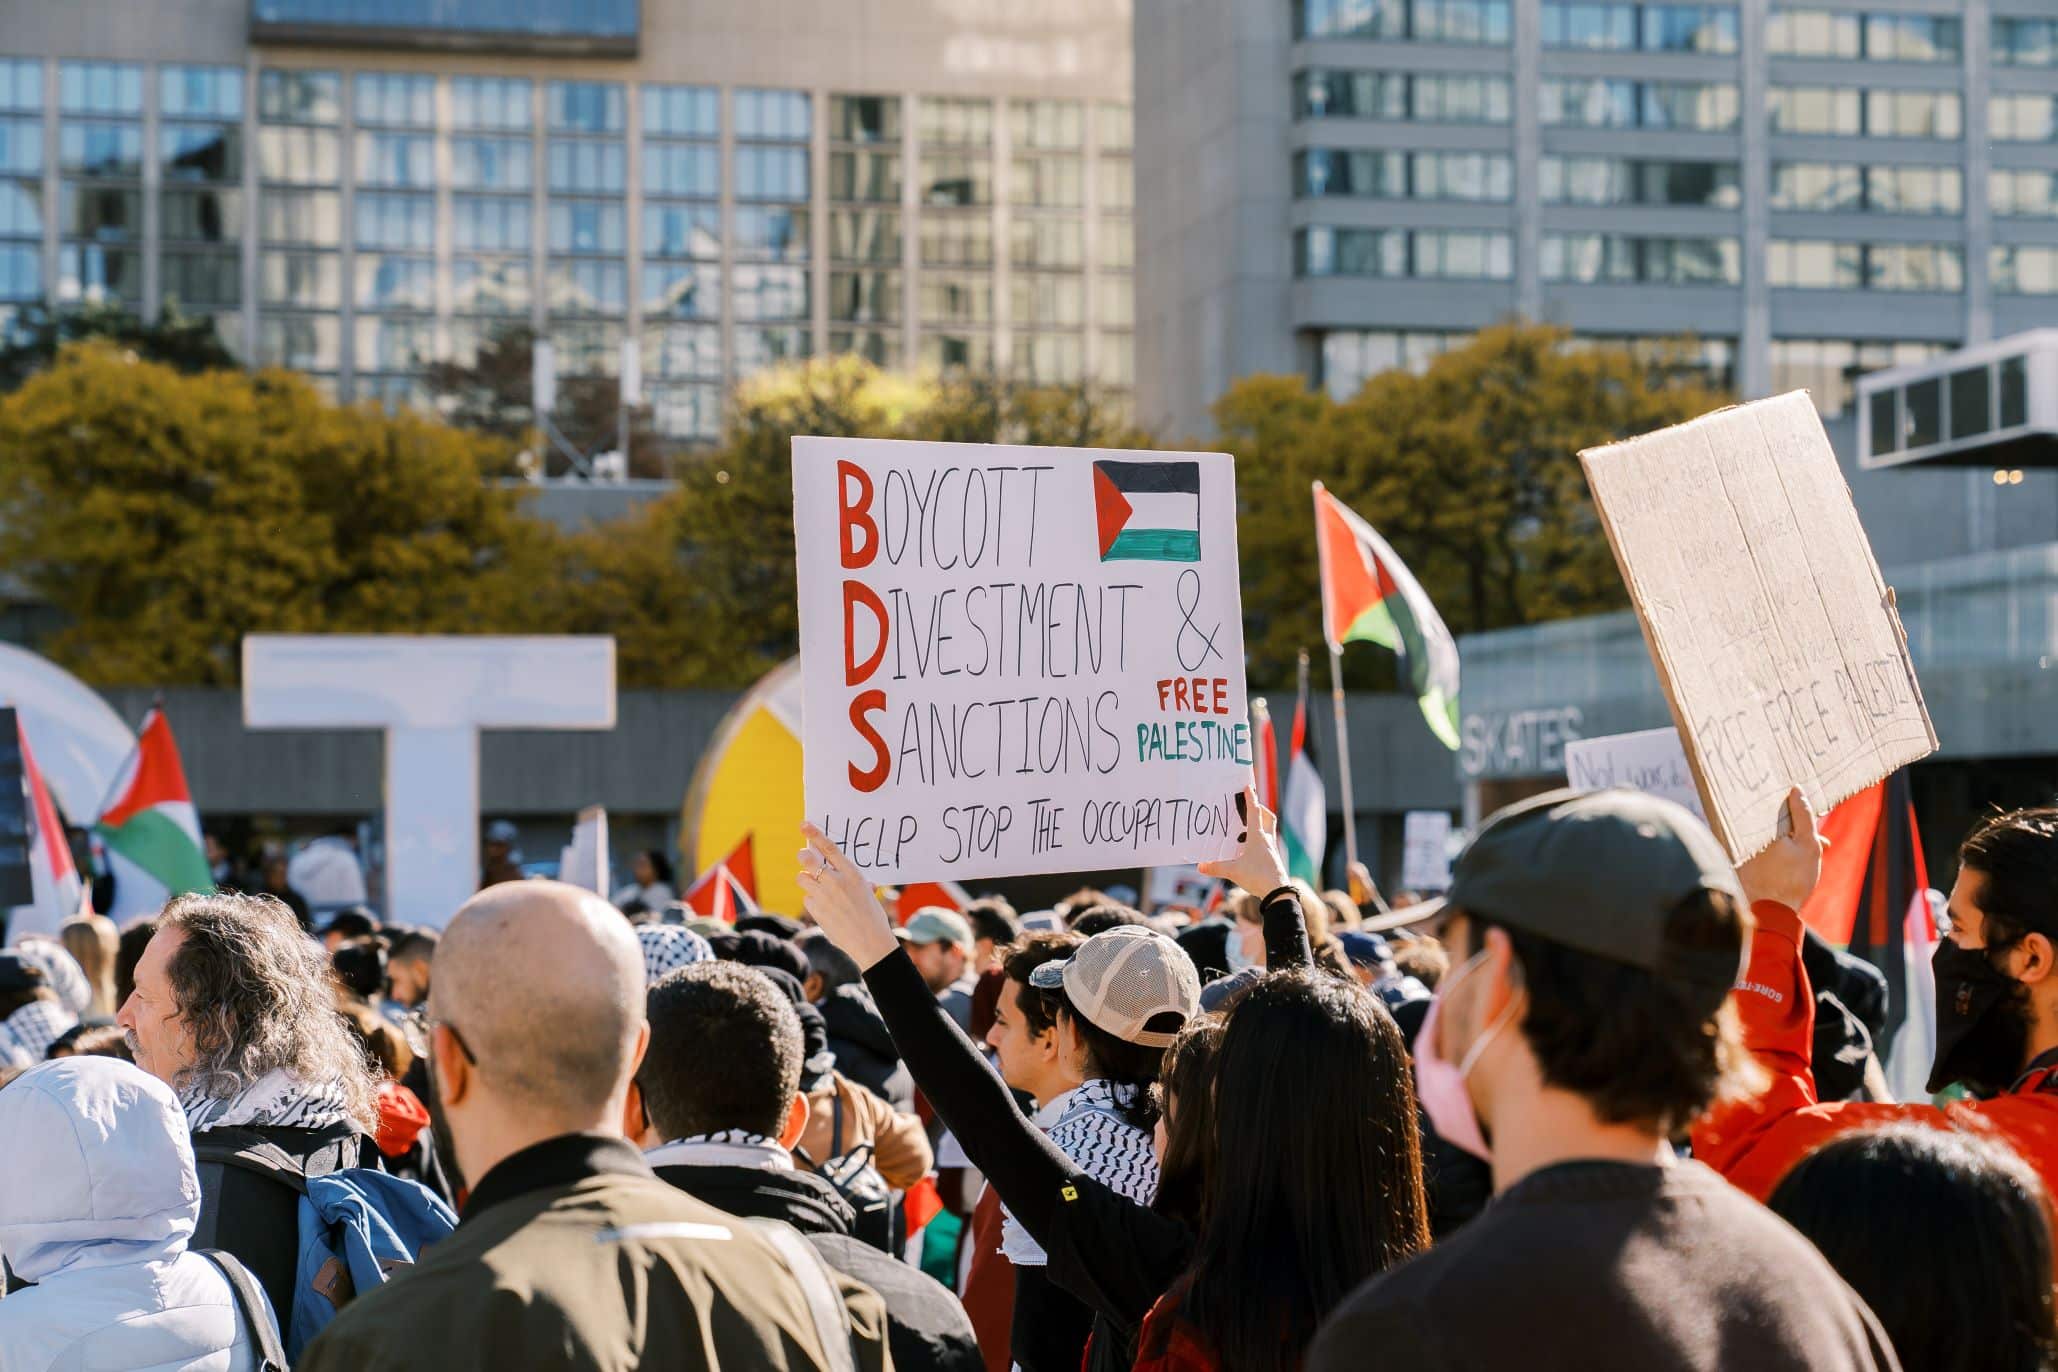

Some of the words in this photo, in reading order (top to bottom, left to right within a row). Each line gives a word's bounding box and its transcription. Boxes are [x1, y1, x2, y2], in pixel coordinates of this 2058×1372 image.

[837, 459, 1054, 570] BOYCOTT
[842, 580, 1143, 687] DIVESTMENT
[1176, 568, 1224, 671] &
[847, 688, 1121, 793] SANCTIONS
[1136, 720, 1253, 765] PALESTINE
[1156, 677, 1229, 714] FREE
[1696, 711, 1770, 796] FREE
[1762, 679, 1839, 784] FREE
[823, 813, 918, 870] HELP
[939, 805, 1013, 864] STOP
[1027, 797, 1063, 856] THE
